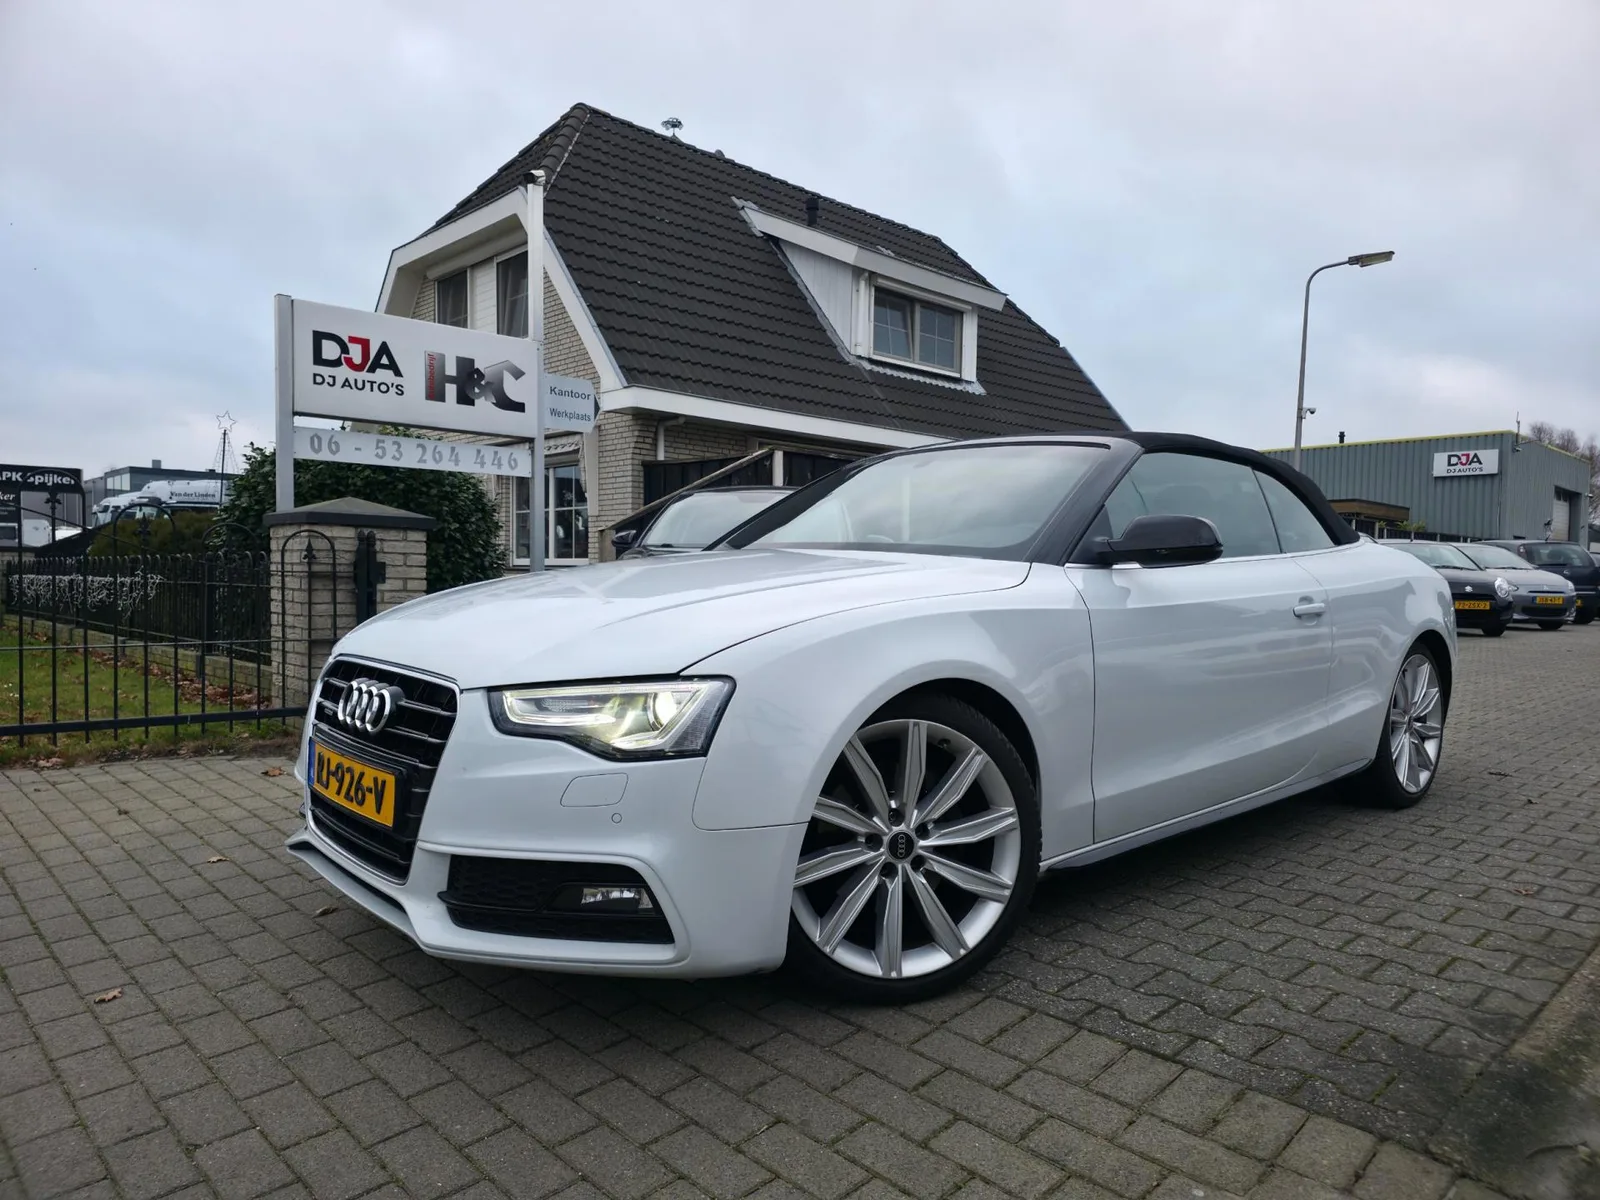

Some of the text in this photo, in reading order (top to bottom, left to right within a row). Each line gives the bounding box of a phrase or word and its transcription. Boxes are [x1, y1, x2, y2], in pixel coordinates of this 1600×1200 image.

[312, 330, 404, 378] DJA
[313, 373, 405, 396] DJ AUTO'S
[425, 350, 526, 413] H&C
[549, 386, 591, 400] Kantoor
[549, 407, 591, 421] Werkplaats
[309, 433, 341, 456] 06
[374, 438, 404, 461] 53
[416, 443, 461, 467] 264
[473, 448, 519, 471] 446
[1447, 453, 1483, 467] DJA
[0, 471, 23, 482] PK
[316, 752, 387, 815] RJ-926-V
